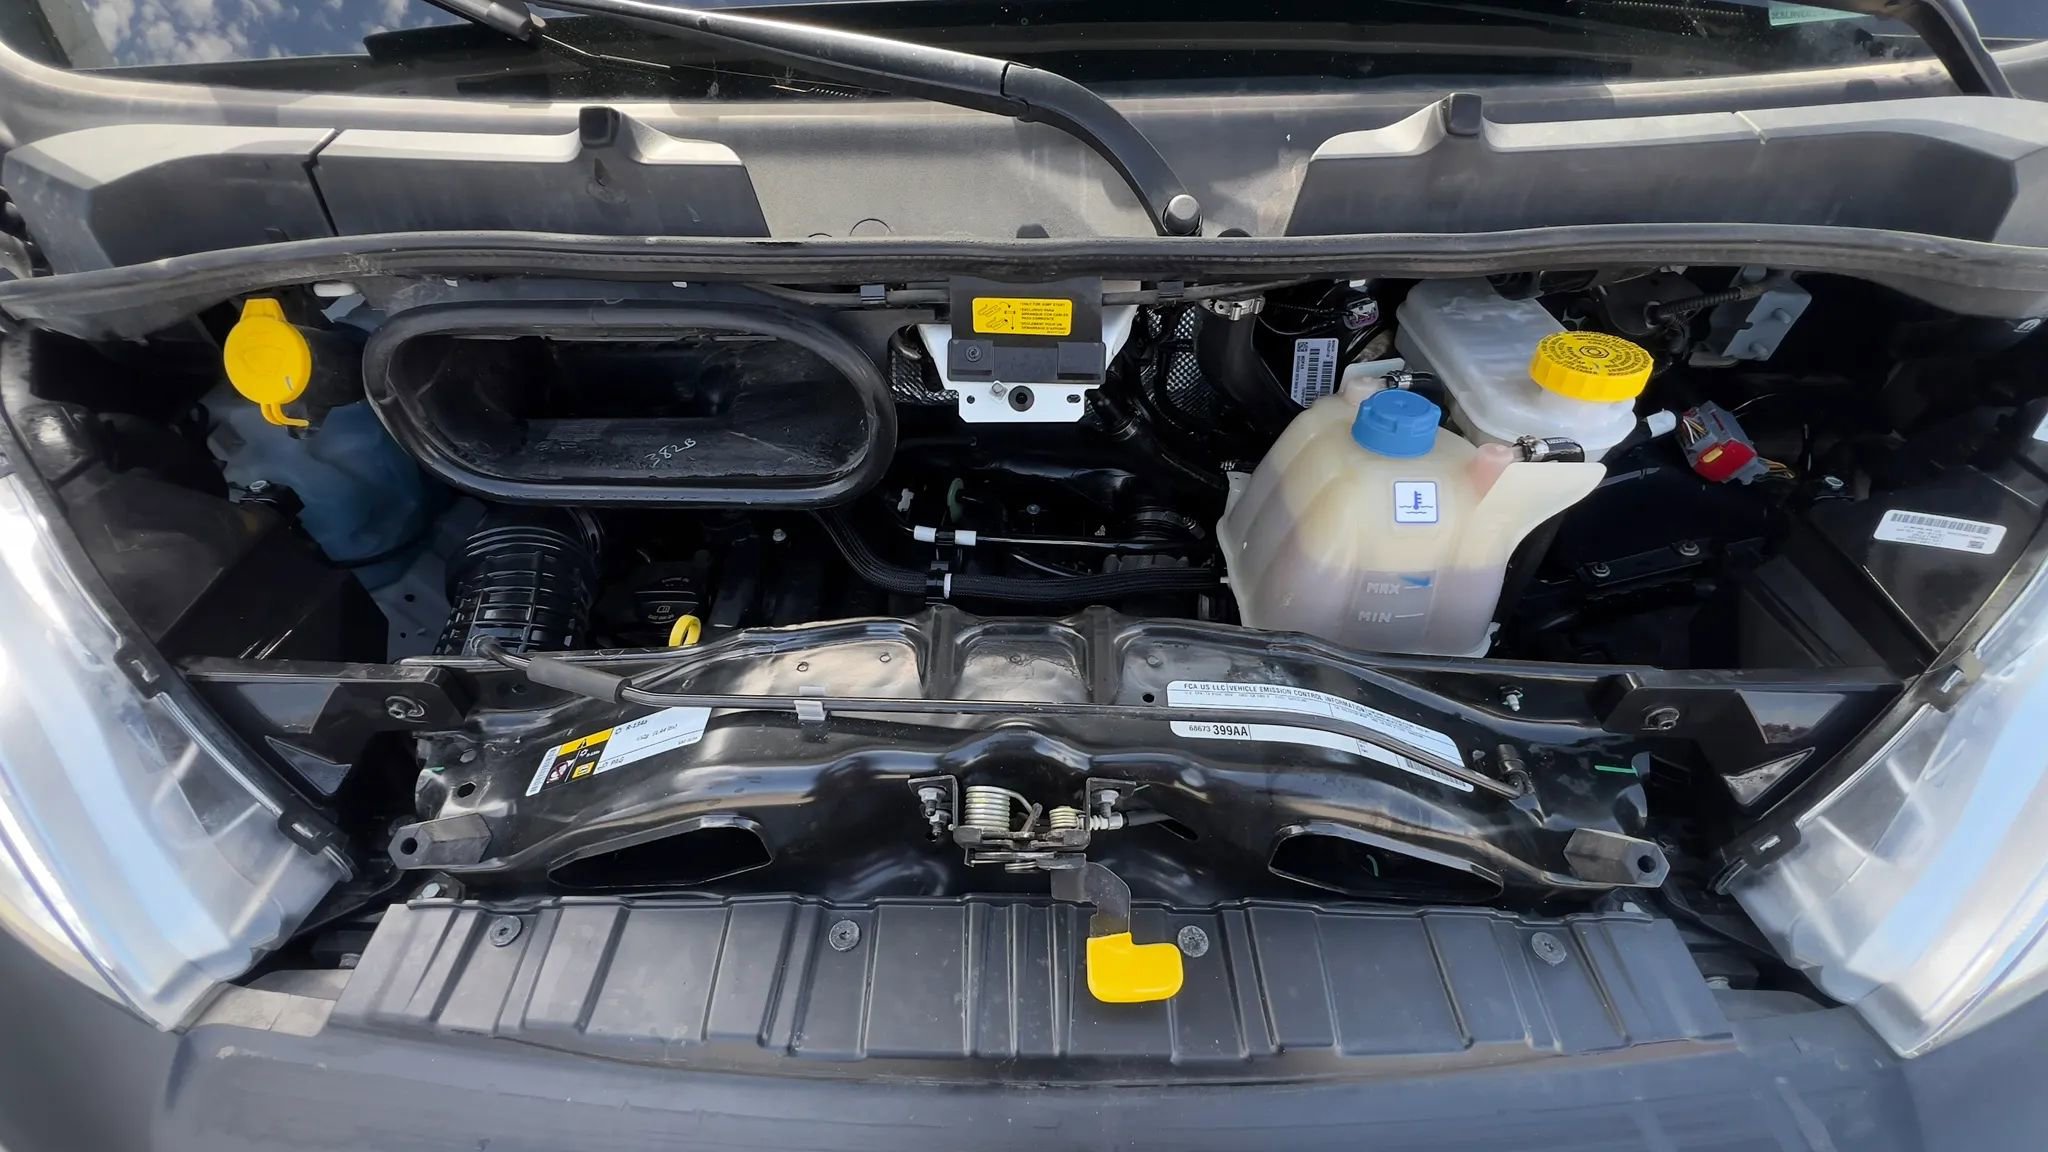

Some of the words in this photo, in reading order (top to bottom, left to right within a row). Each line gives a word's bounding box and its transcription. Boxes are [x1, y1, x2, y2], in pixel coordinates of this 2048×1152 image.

[1366, 582, 1400, 594] MAX
[1358, 611, 1392, 623] MIN
[1259, 687, 1292, 695] EMISSION
[1293, 690, 1323, 700] CONTROL
[1324, 696, 1365, 712] INFORMATION
[1213, 724, 1248, 736] 399AA
